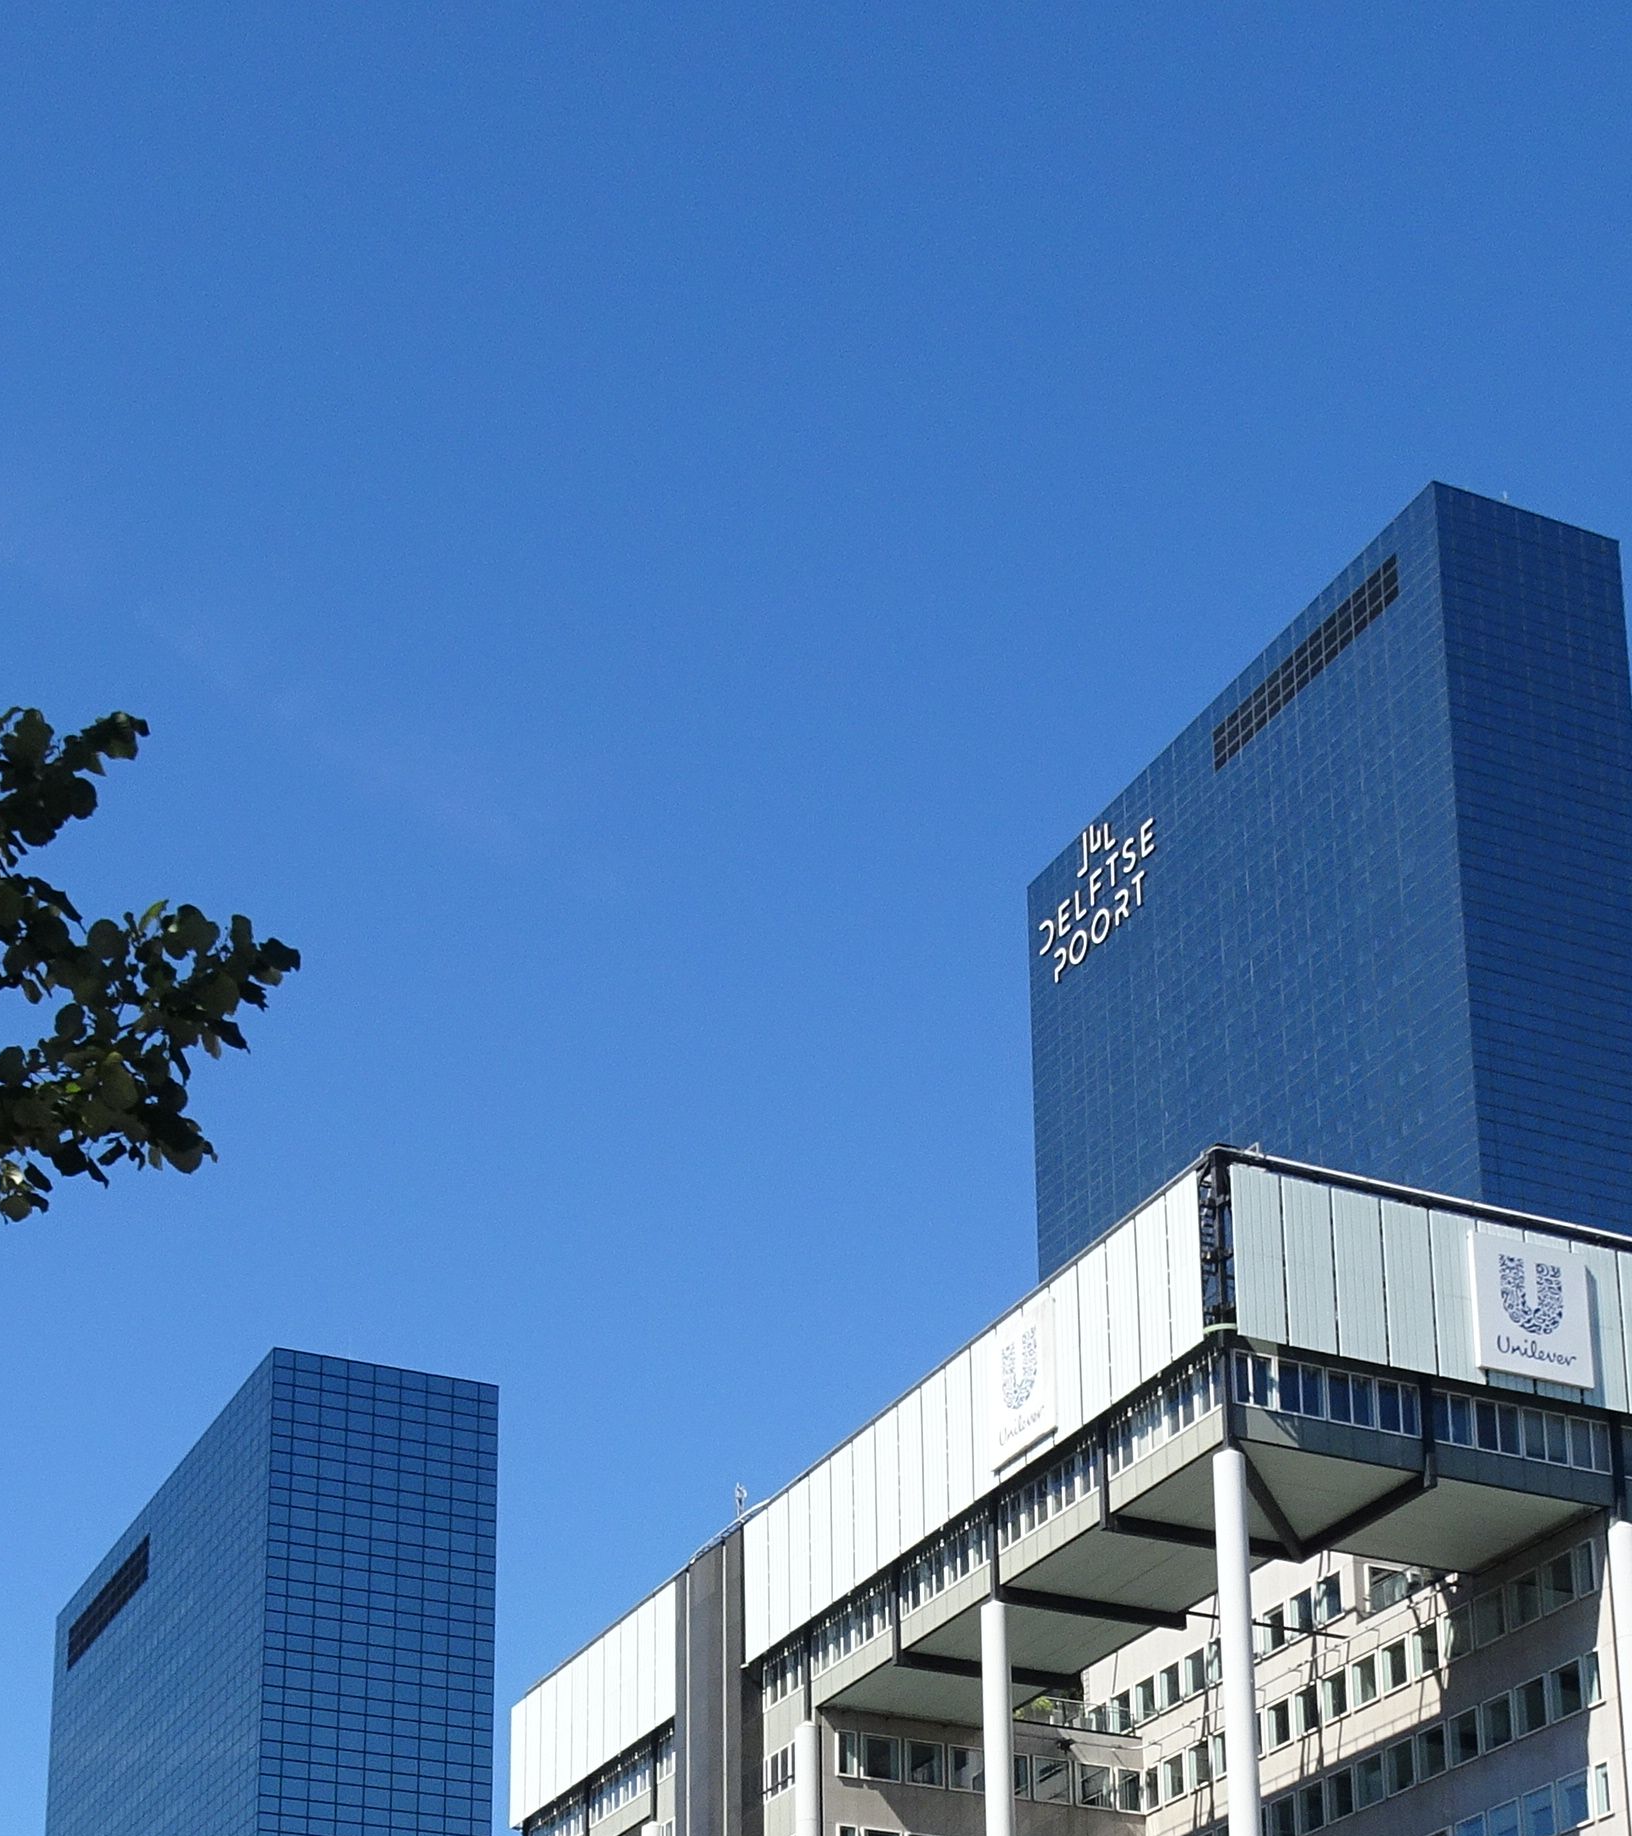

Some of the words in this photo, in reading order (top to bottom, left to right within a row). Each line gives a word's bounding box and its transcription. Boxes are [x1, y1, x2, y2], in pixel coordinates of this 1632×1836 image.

[1039, 817, 1156, 955] DELFTSE
[1054, 870, 1145, 983] POORT
[1496, 1335, 1577, 1367] Unilever
[998, 1404, 1046, 1447] Unilever
